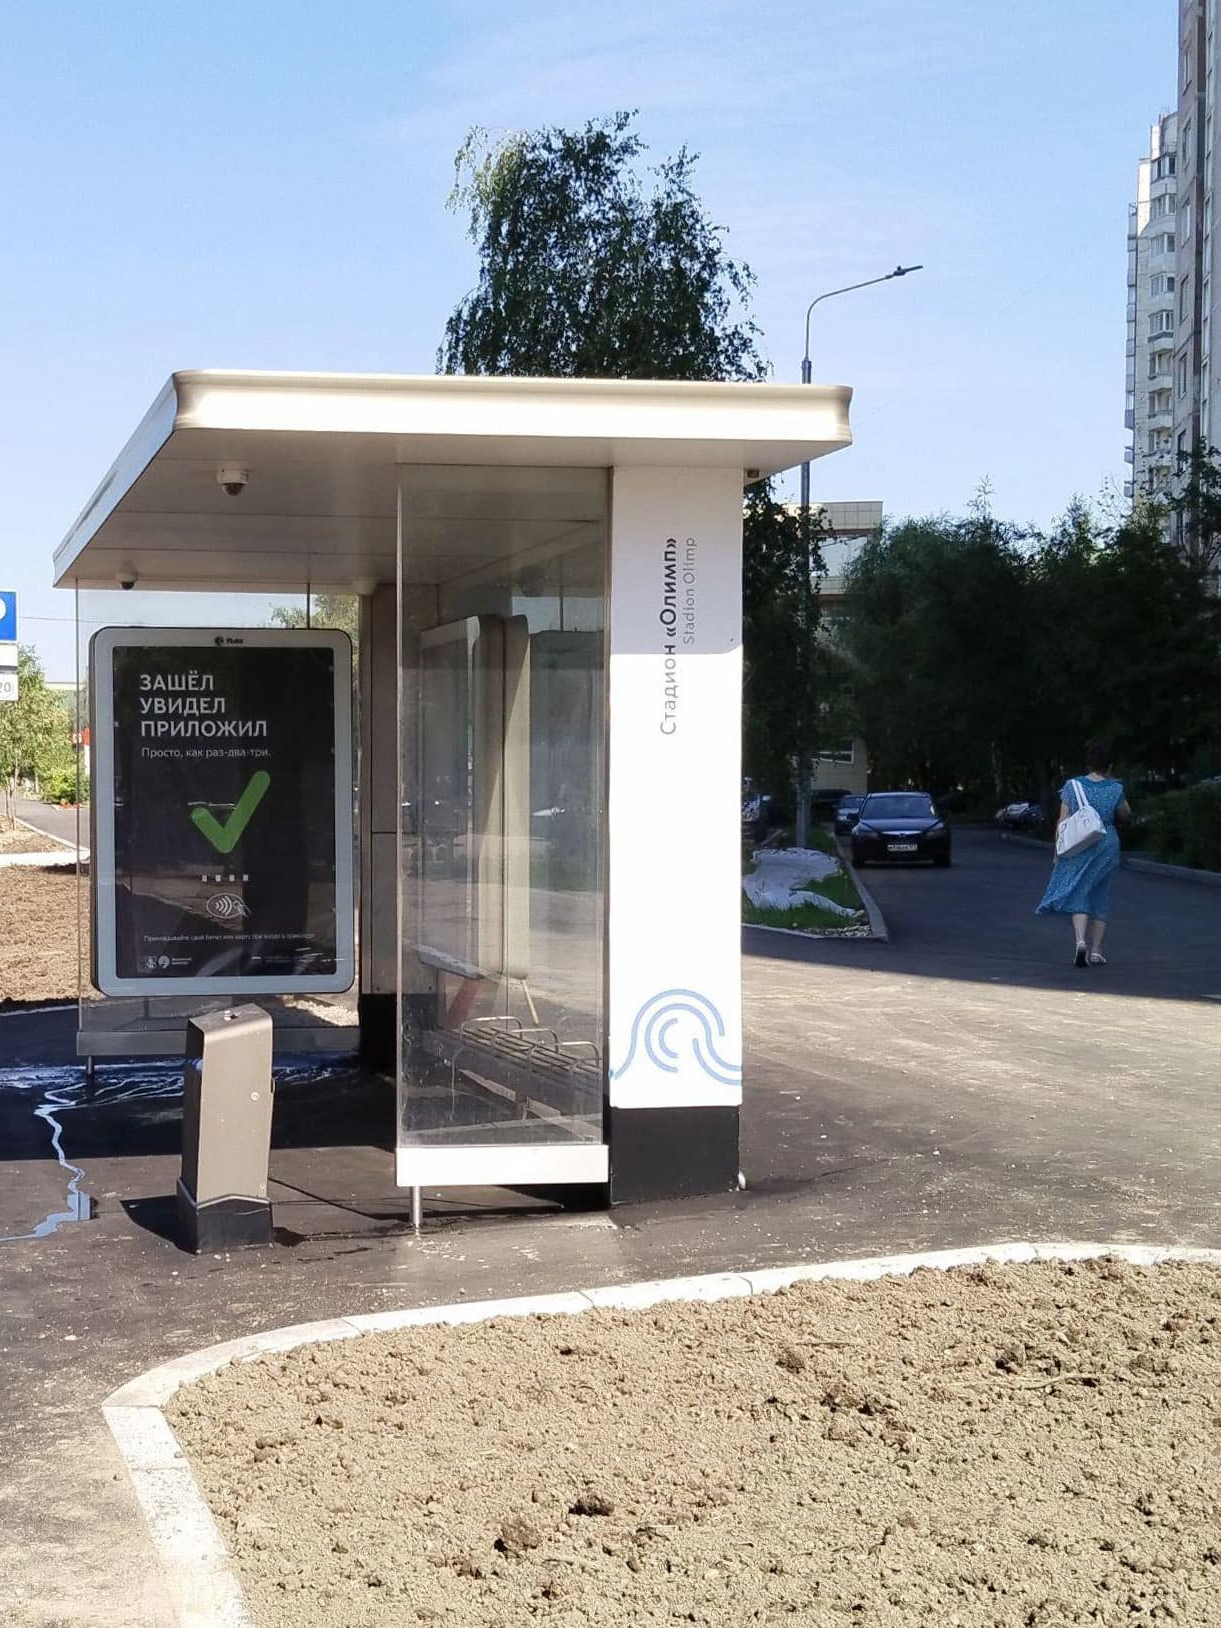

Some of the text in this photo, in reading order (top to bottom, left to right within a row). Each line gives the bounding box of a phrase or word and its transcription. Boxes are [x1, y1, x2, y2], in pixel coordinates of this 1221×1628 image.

[682, 537, 697, 645] Stadion Olimp
[659, 537, 678, 735] Стадион «Олимп»
[139, 670, 214, 691] ЗАШЁЛ
[139, 697, 226, 717] УВИДЕЛ
[141, 720, 268, 737] ПРИЛОЖИЛ
[141, 747, 183, 759] Просто,
[186, 748, 203, 757] как
